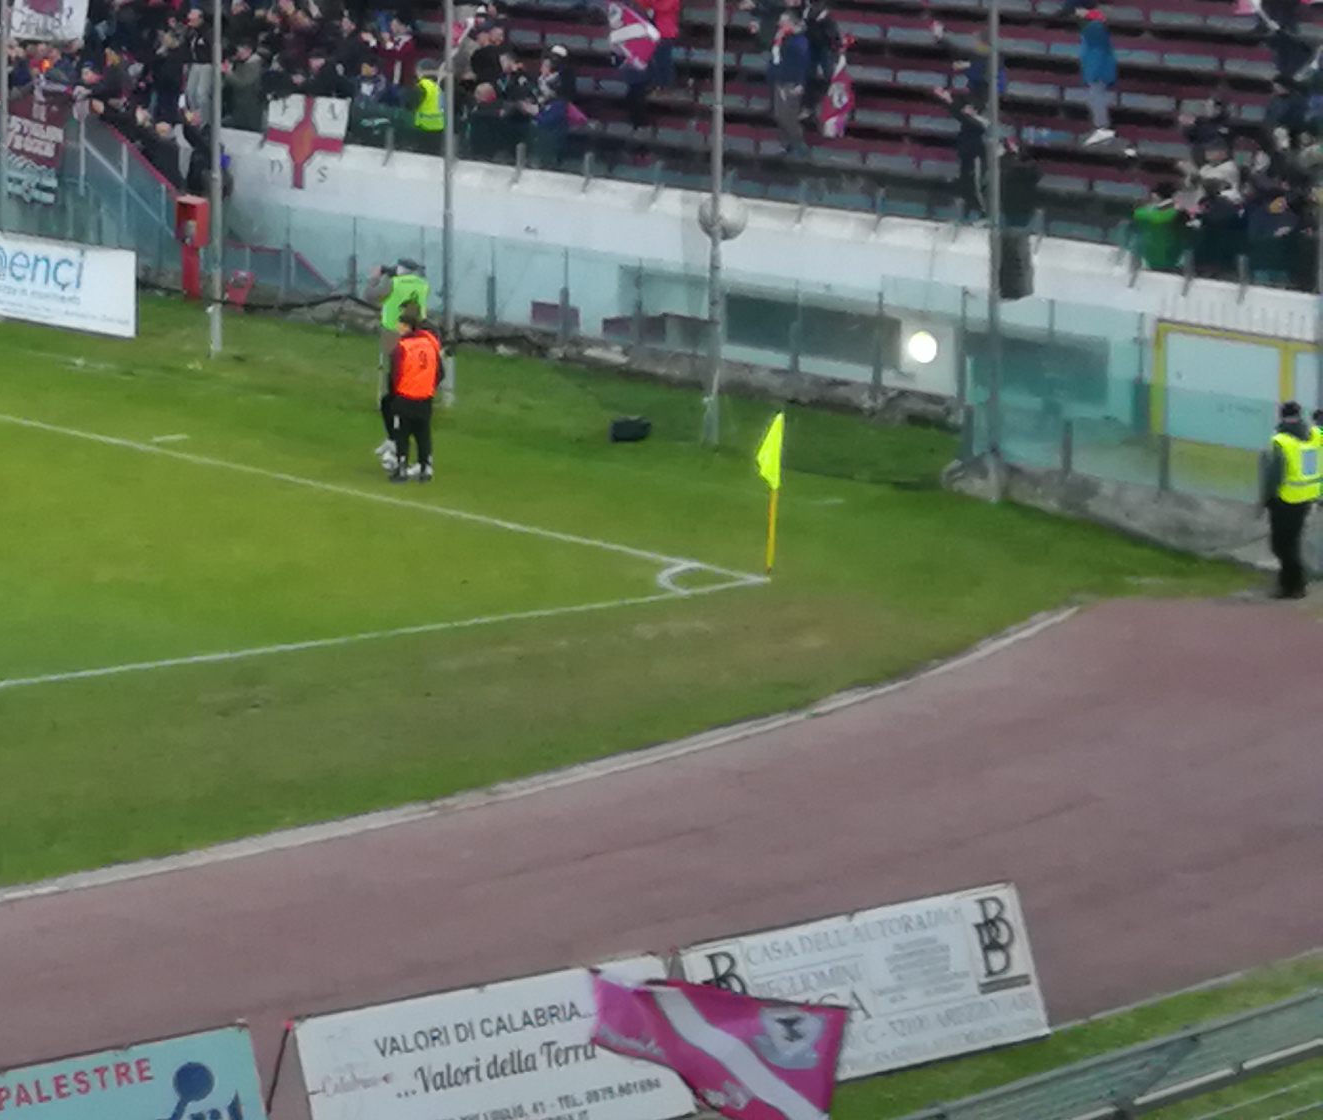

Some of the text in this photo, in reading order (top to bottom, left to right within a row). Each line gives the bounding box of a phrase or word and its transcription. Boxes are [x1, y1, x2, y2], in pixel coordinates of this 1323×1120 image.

[746, 938, 800, 967] CASA
[373, 1025, 451, 1058] VALORI
[454, 1020, 477, 1044] DI
[486, 1042, 539, 1082] della
[540, 1038, 599, 1070] Terra
